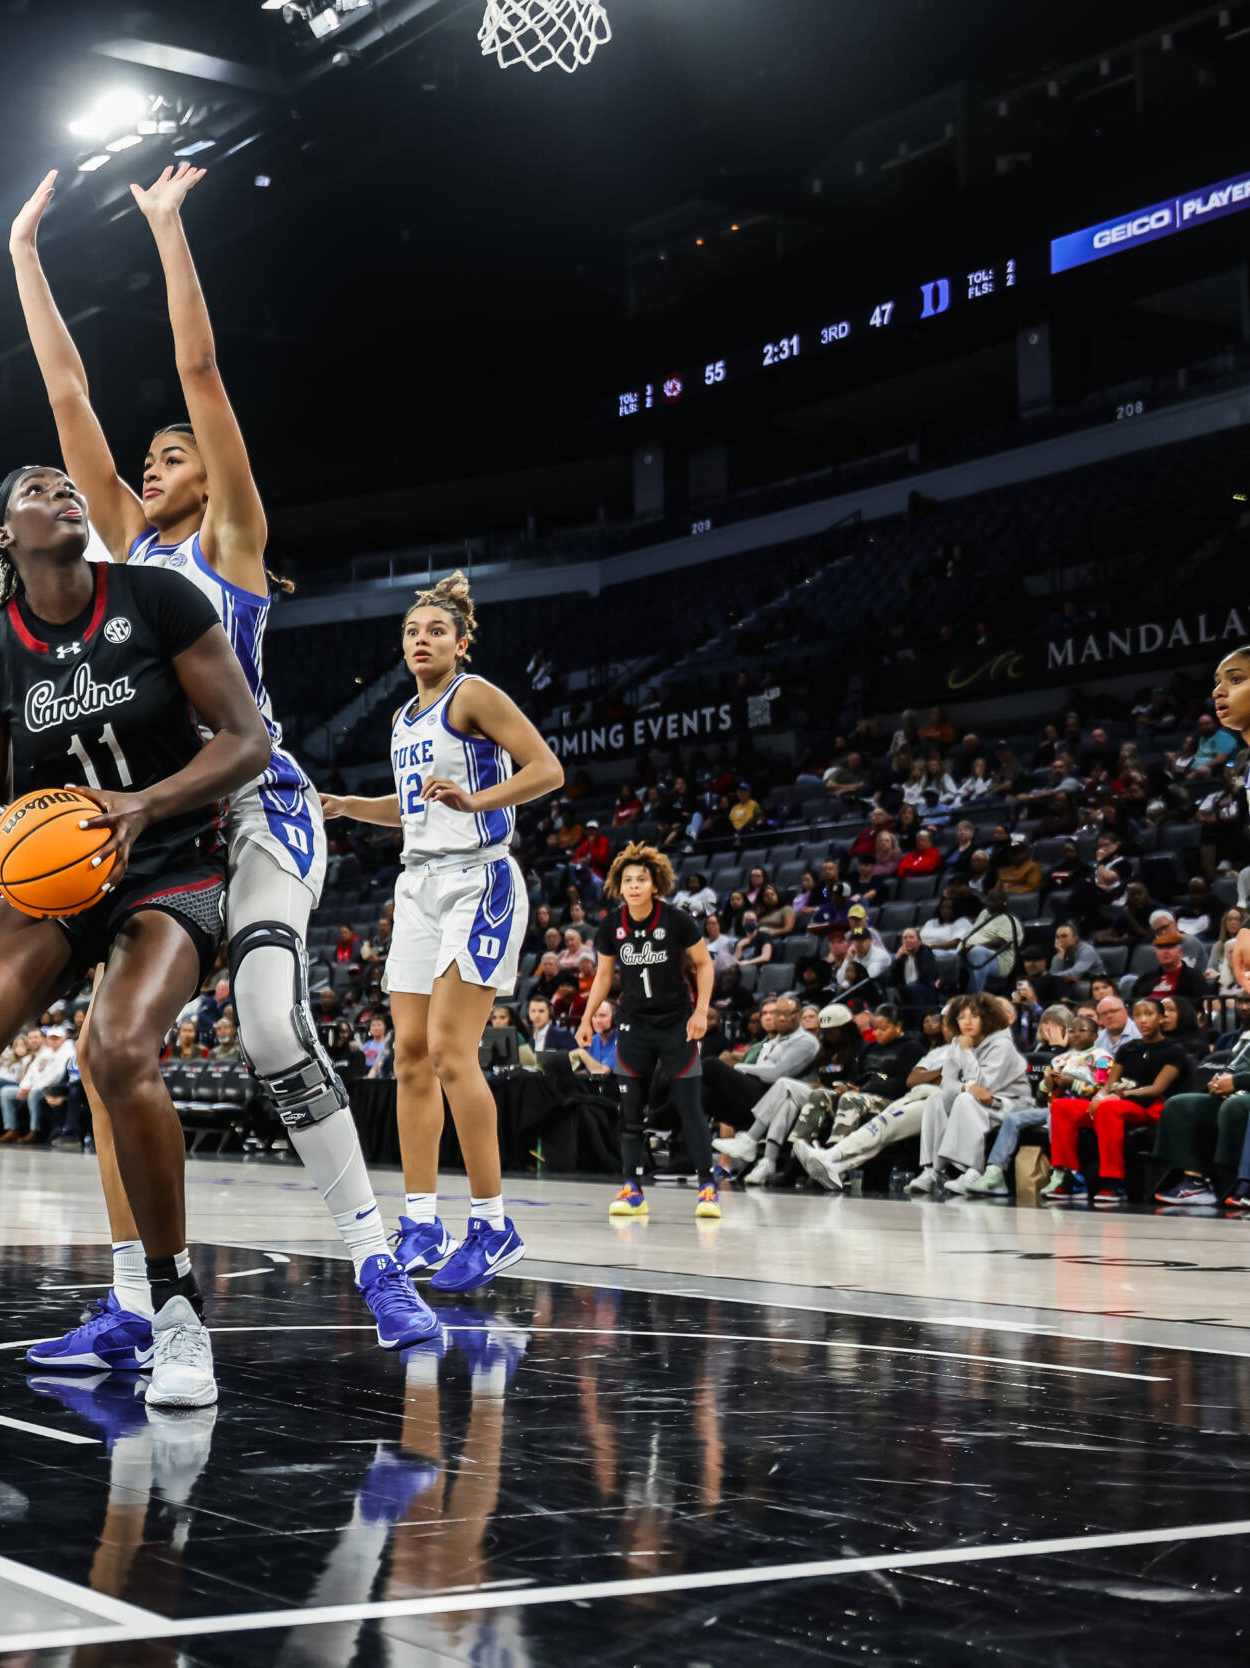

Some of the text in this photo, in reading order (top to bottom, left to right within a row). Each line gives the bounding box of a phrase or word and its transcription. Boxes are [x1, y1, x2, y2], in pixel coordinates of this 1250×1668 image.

[1092, 208, 1173, 249] GEICO
[919, 277, 950, 319] D
[869, 301, 895, 328] 47
[820, 321, 850, 344] 3RD
[762, 334, 801, 367] 2:31
[704, 360, 726, 386] 55
[1115, 400, 1144, 420] 208
[690, 517, 712, 536] 209
[107, 622, 131, 640] SEC
[1046, 606, 1250, 671] MANDALA
[25, 663, 136, 733] Carolina
[632, 703, 733, 747] EVENTS
[66, 722, 133, 792] 11
[1, 791, 82, 834] Wilson
[281, 822, 310, 856] D
[475, 934, 501, 960] D
[620, 941, 668, 966] Carolina
[639, 967, 652, 999] 1
